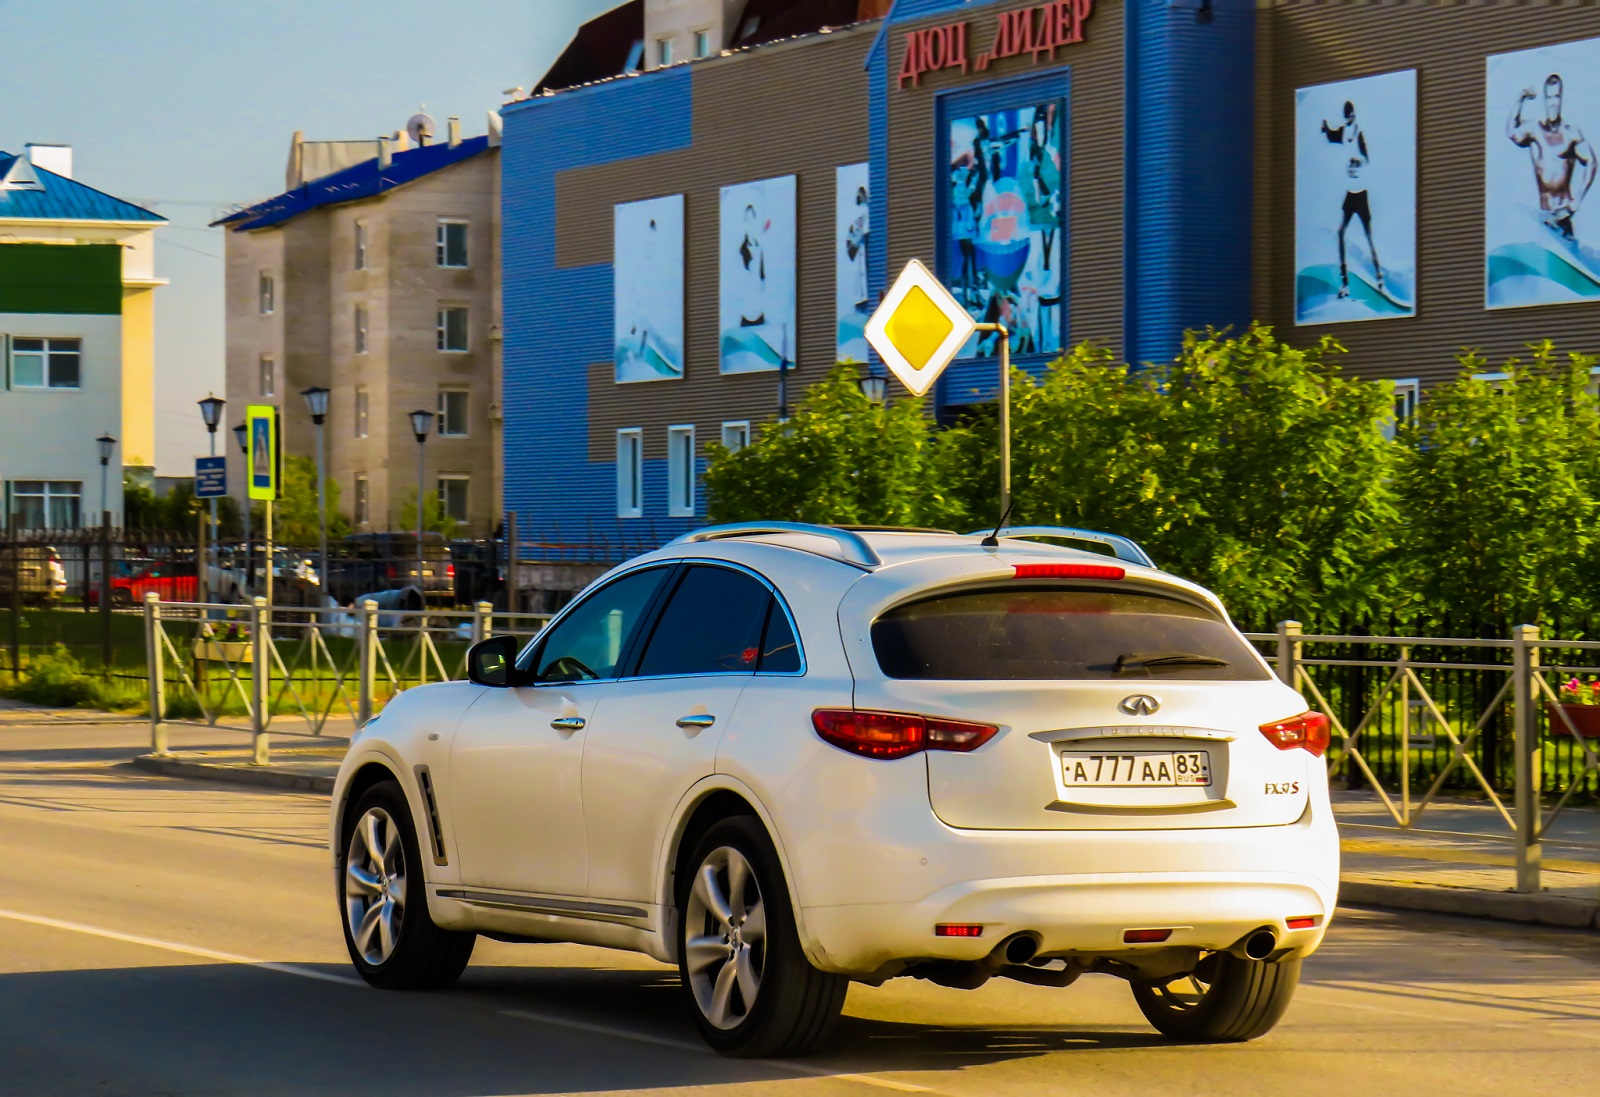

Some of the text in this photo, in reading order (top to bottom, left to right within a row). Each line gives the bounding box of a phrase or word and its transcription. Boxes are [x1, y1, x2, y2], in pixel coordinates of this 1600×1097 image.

[897, 22, 967, 90] ДЮЦ
[1176, 754, 1200, 774] 83
[1177, 774, 1195, 782] RUS
